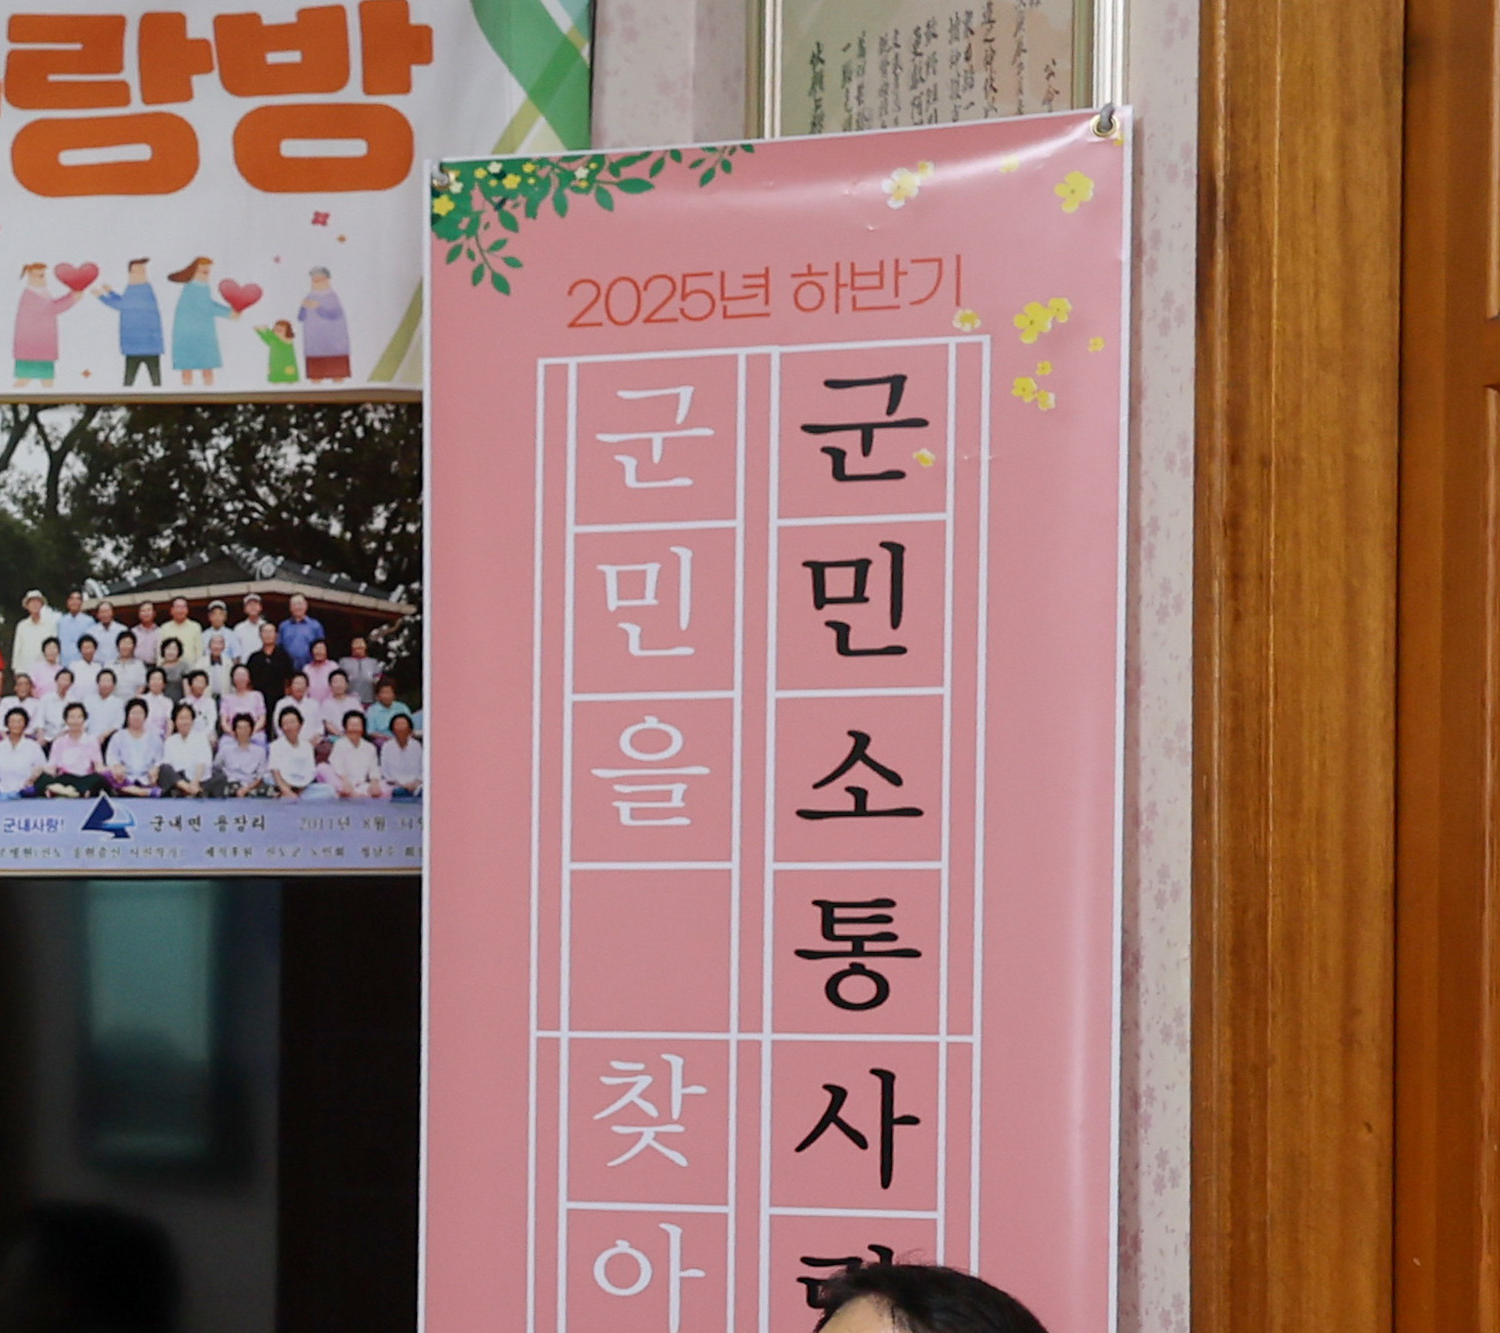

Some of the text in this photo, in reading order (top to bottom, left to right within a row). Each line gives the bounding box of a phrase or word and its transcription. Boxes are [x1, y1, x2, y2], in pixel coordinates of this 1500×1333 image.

[567, 254, 964, 329] 2025년 하반기
[591, 385, 715, 827] 군민을
